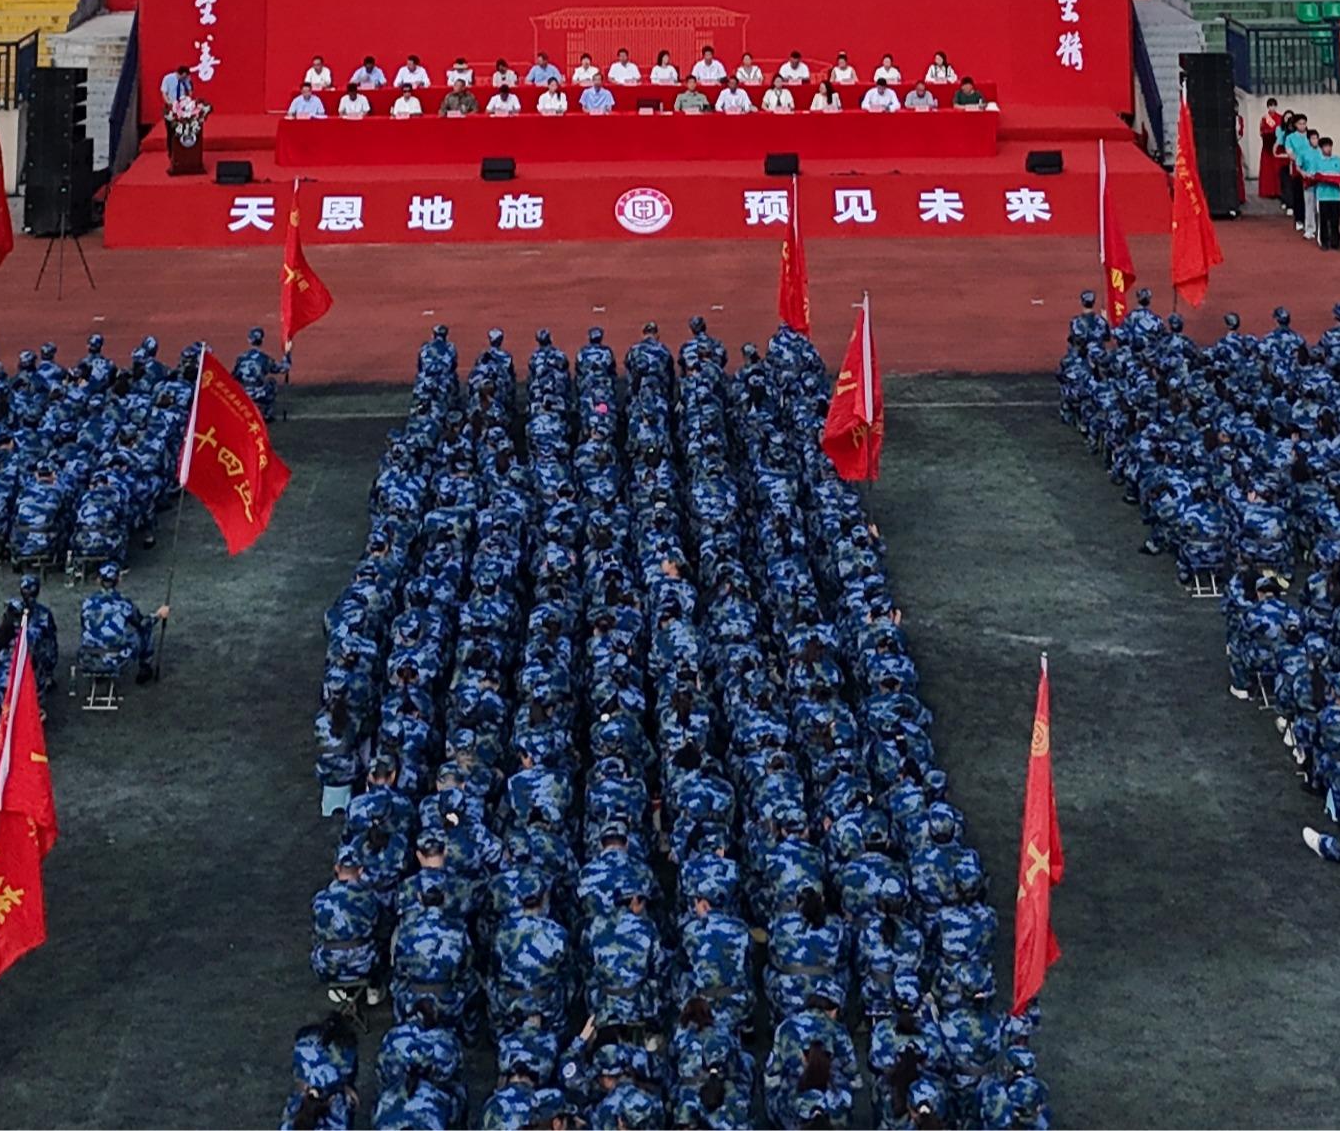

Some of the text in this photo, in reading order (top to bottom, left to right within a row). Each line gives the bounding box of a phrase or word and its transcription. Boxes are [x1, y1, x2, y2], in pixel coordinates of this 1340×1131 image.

[227, 187, 1052, 232] 天恩地施 预见未来
